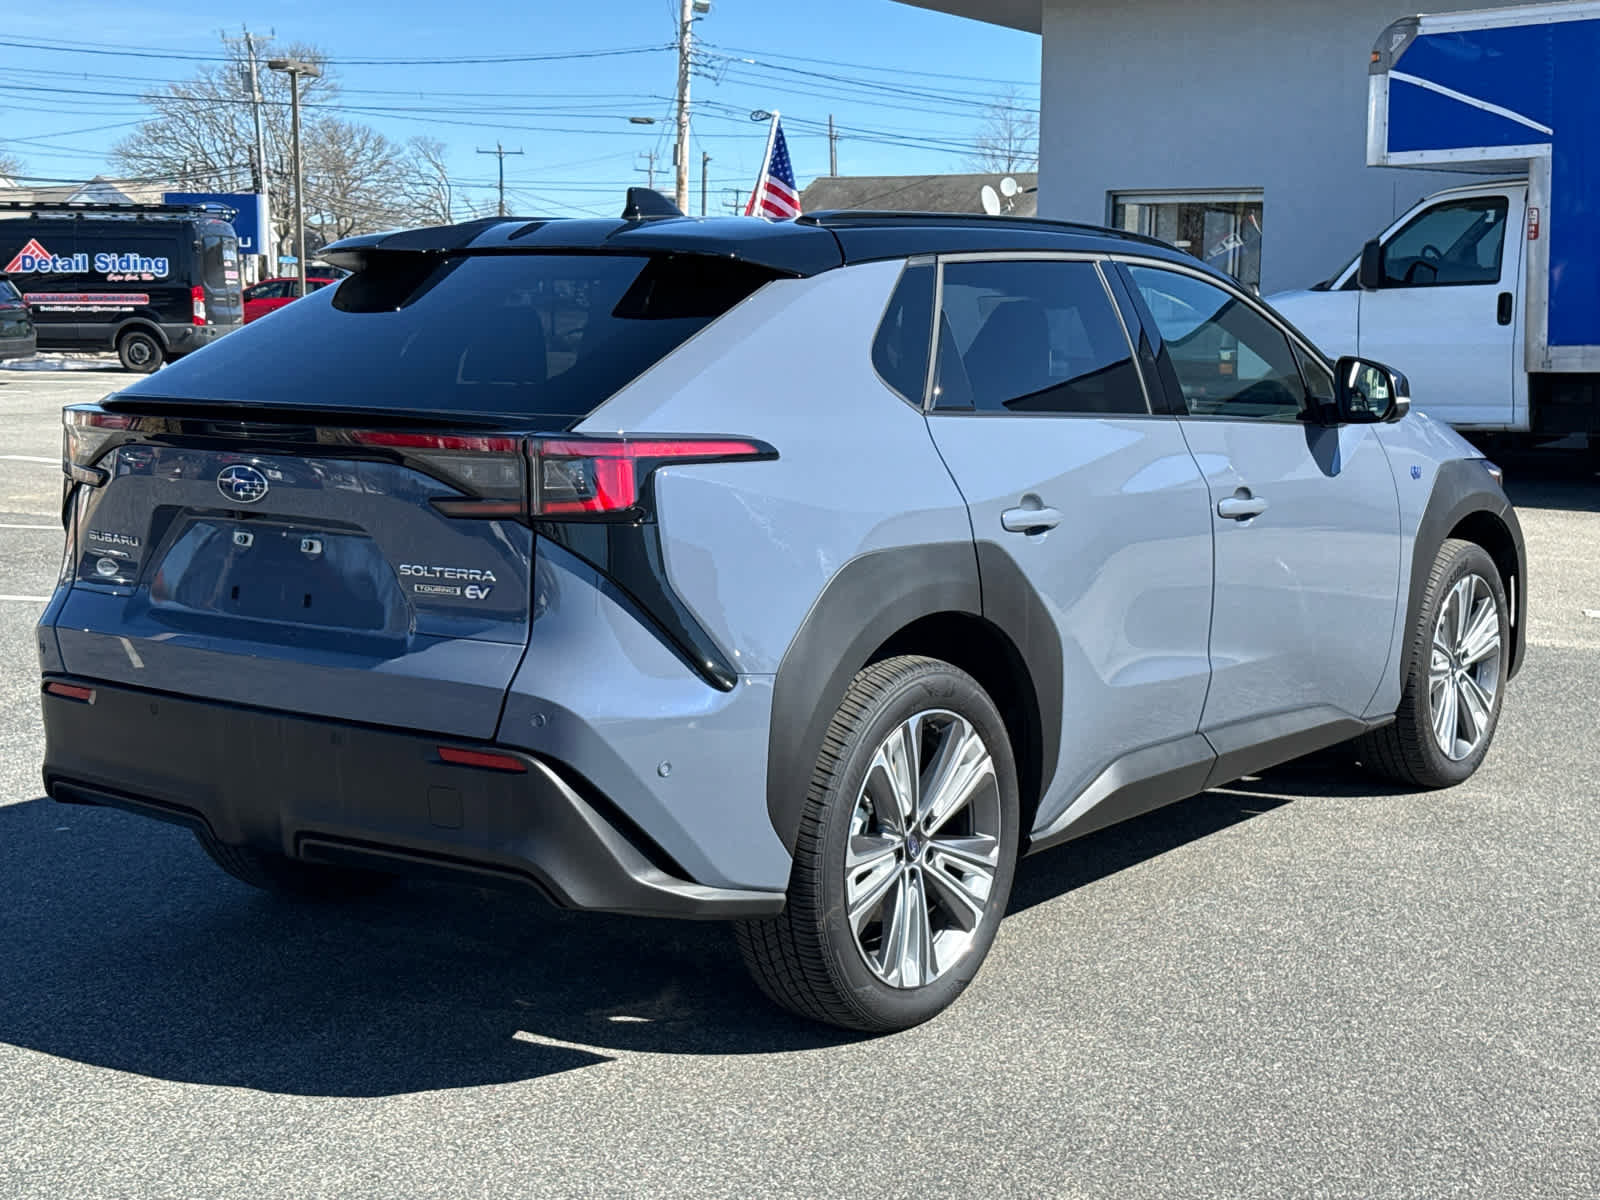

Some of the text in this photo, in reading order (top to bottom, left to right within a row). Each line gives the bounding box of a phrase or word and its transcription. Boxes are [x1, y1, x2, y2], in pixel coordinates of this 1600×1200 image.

[21, 253, 168, 277] Detail Siding
[88, 529, 139, 547] SUBARU
[399, 564, 497, 582] SOLTERRA
[420, 585, 490, 599] TOURING EV
